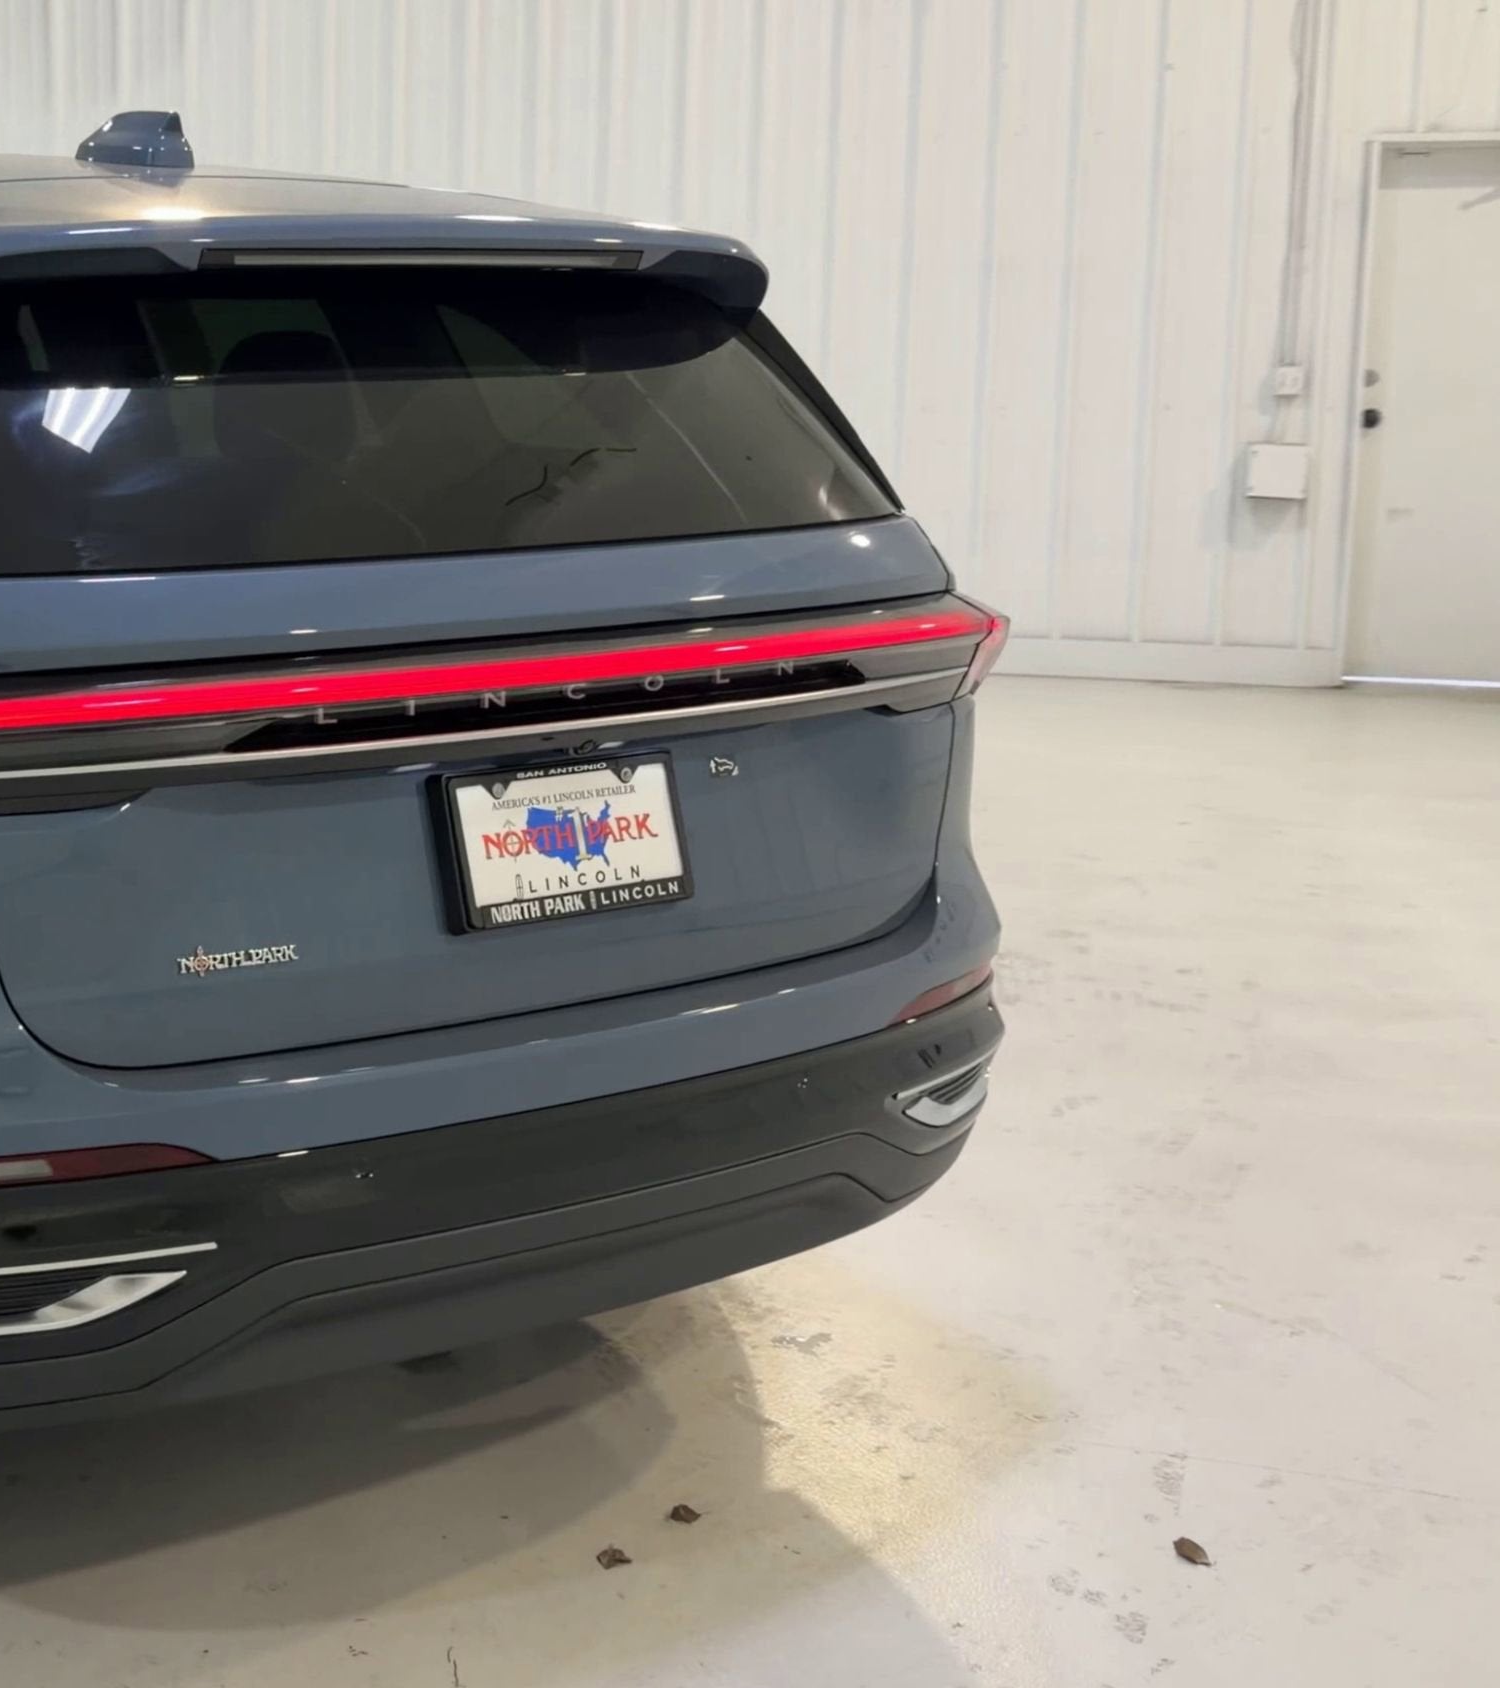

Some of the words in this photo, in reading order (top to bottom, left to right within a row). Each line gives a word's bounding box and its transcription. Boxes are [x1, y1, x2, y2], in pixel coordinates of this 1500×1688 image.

[314, 660, 794, 726] LINCOLN
[516, 769, 544, 780] SAN
[548, 762, 608, 775] ANTONIO
[491, 795, 541, 811] AMERICA'S
[542, 794, 551, 804] #1
[553, 789, 595, 803] LINCOLN
[595, 784, 636, 798] RETAILER
[482, 821, 576, 860] NORTH
[586, 813, 659, 846] PARK
[528, 865, 641, 894] LINCOLN
[490, 899, 542, 924] NORTH
[543, 893, 586, 916] PARK
[601, 880, 680, 905] LINCOLN
[177, 947, 246, 976] NORTH
[249, 944, 299, 965] PARK
